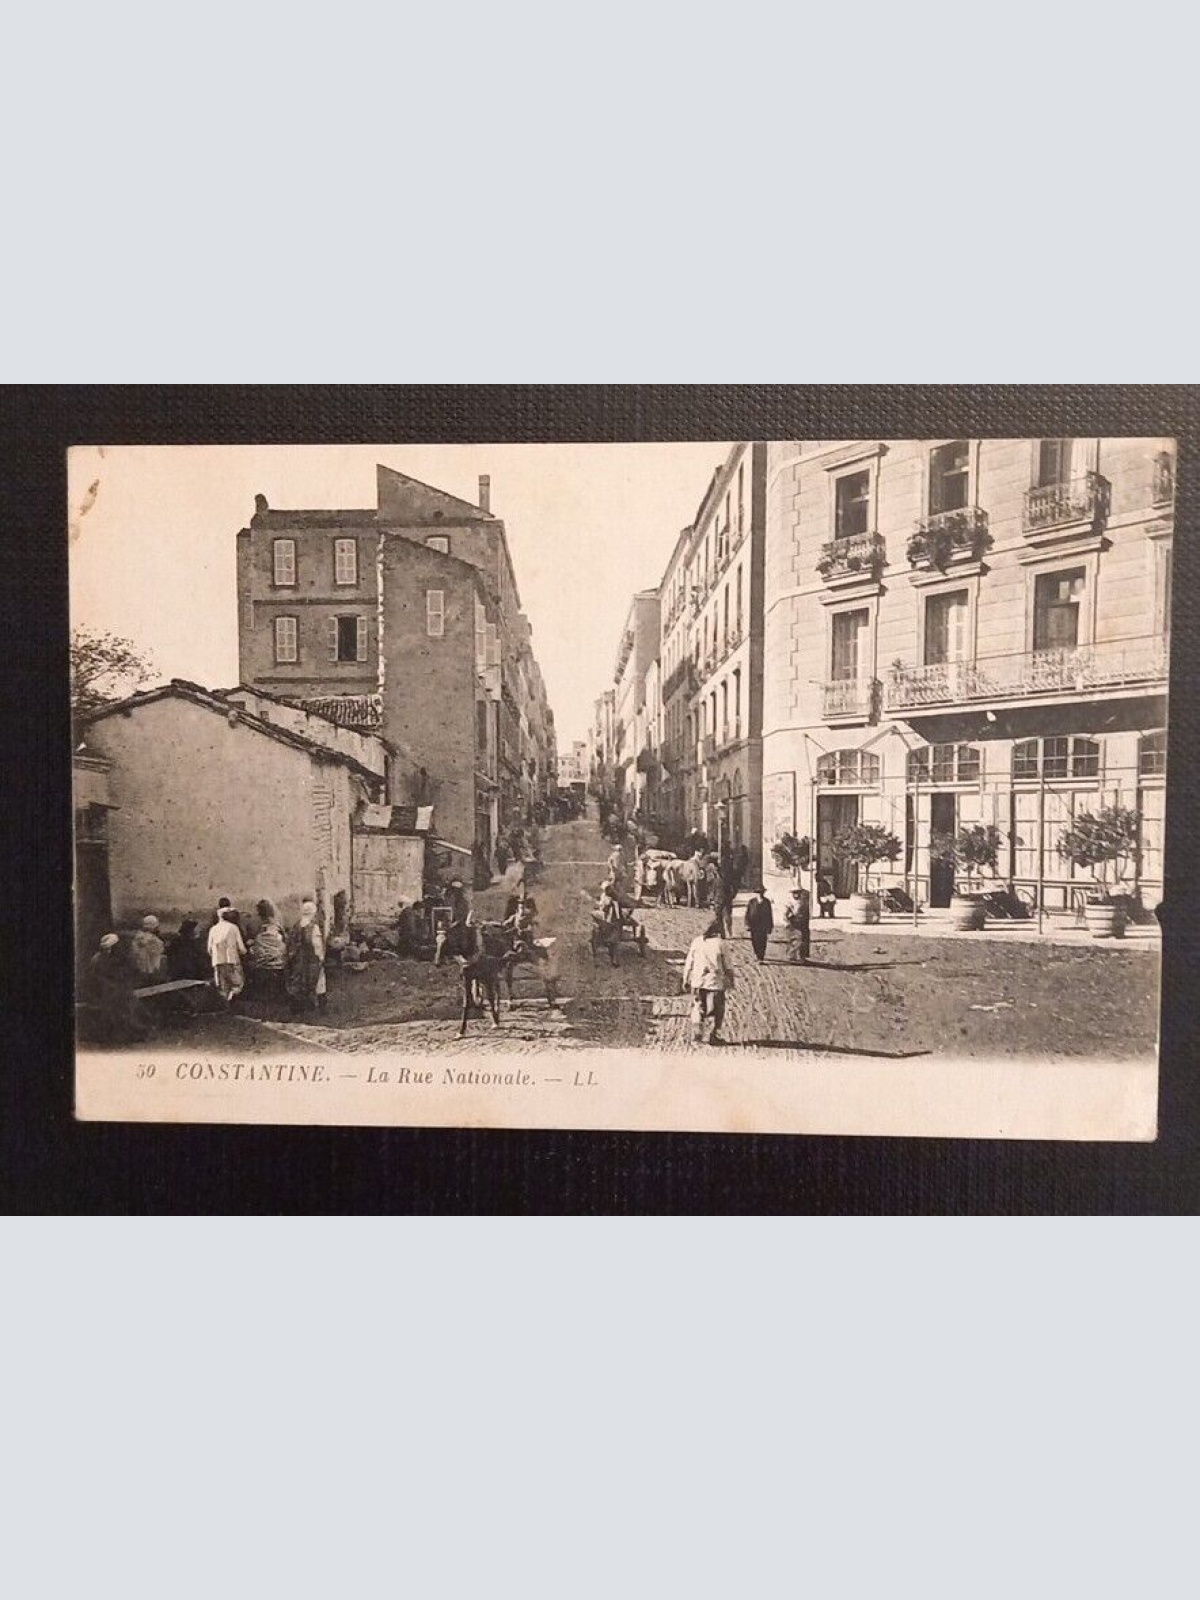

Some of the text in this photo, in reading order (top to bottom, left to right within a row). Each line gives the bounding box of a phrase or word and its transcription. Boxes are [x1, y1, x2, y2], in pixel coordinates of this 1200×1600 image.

[175, 1062, 331, 1083] CONSTANTINE.
[366, 1066, 390, 1084] La
[397, 1067, 434, 1085] Rue
[441, 1068, 537, 1087] Nationale.
[572, 1071, 599, 1088] LL
